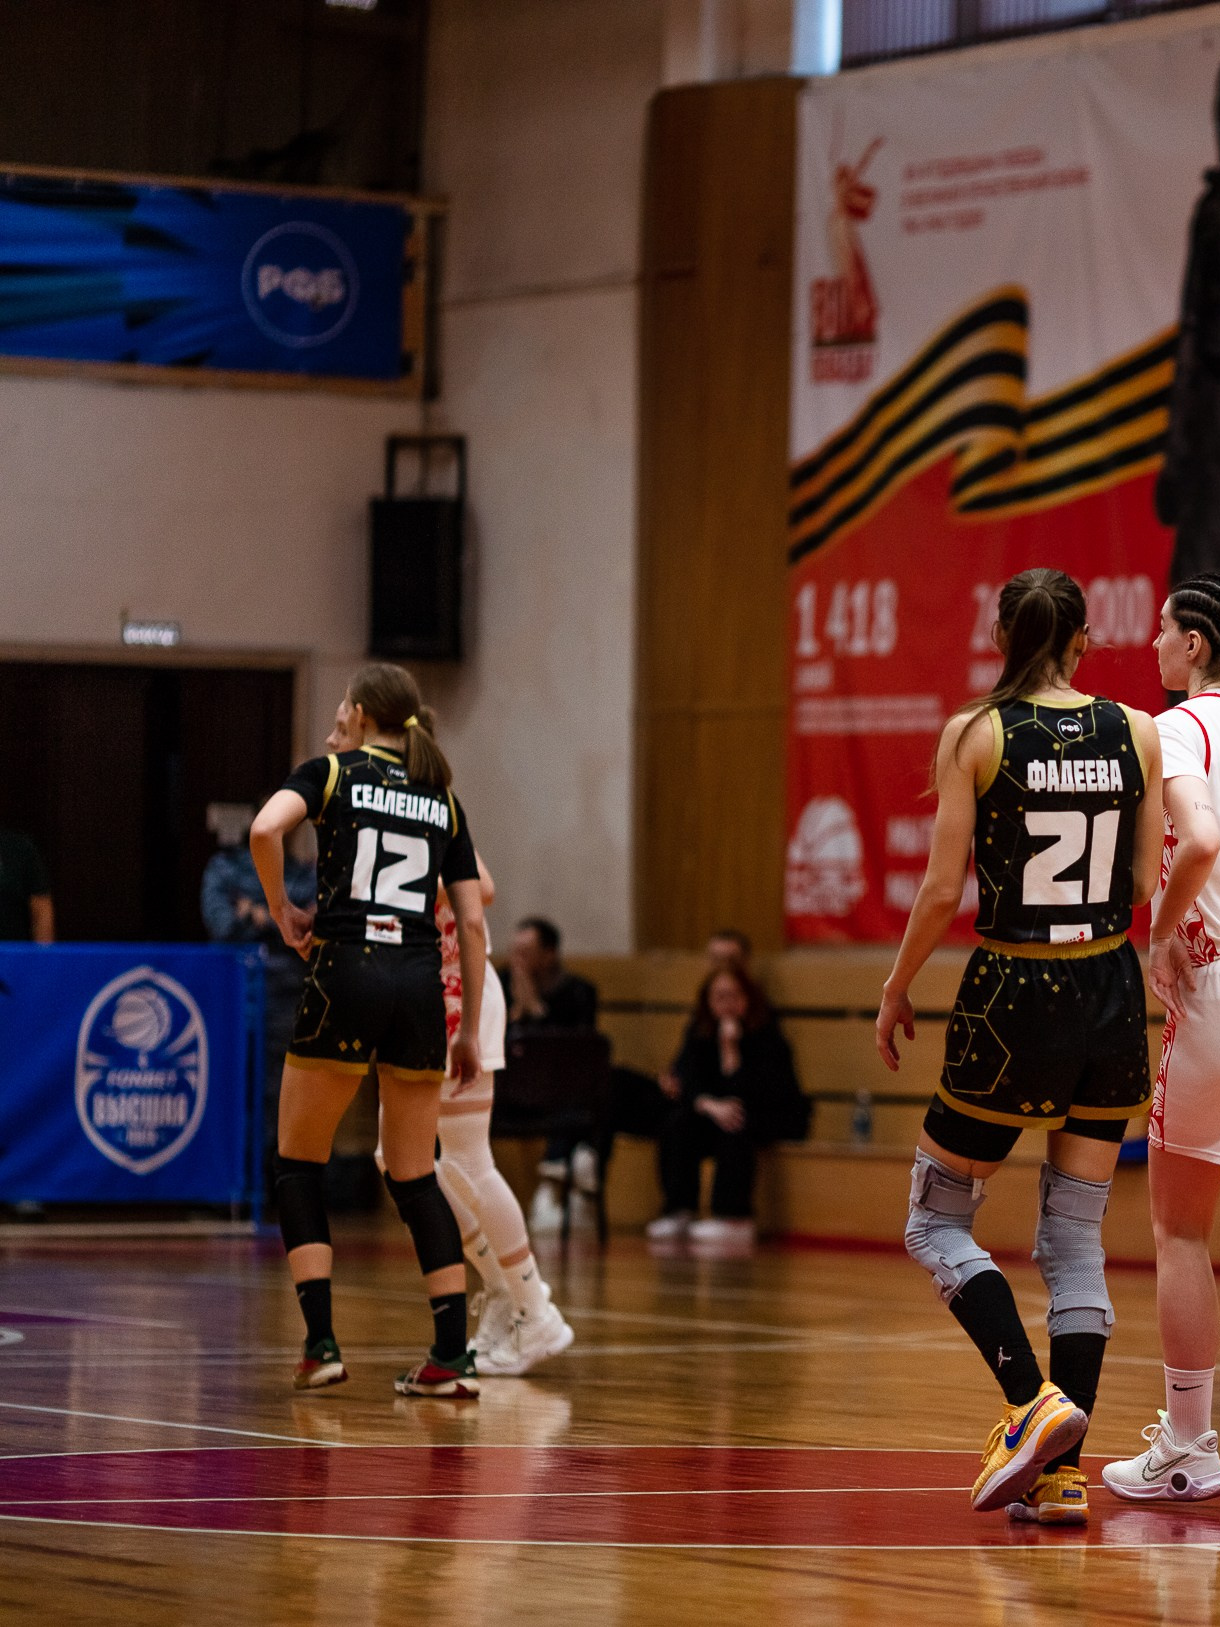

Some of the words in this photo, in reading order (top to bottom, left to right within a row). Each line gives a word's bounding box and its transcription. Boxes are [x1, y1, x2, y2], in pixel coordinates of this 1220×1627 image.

[351, 784, 449, 831] СЕДЛЕЦКАЯ
[1027, 759, 1124, 792] ФАДЕЕВА
[350, 826, 430, 913] 12
[1022, 810, 1121, 905] 21
